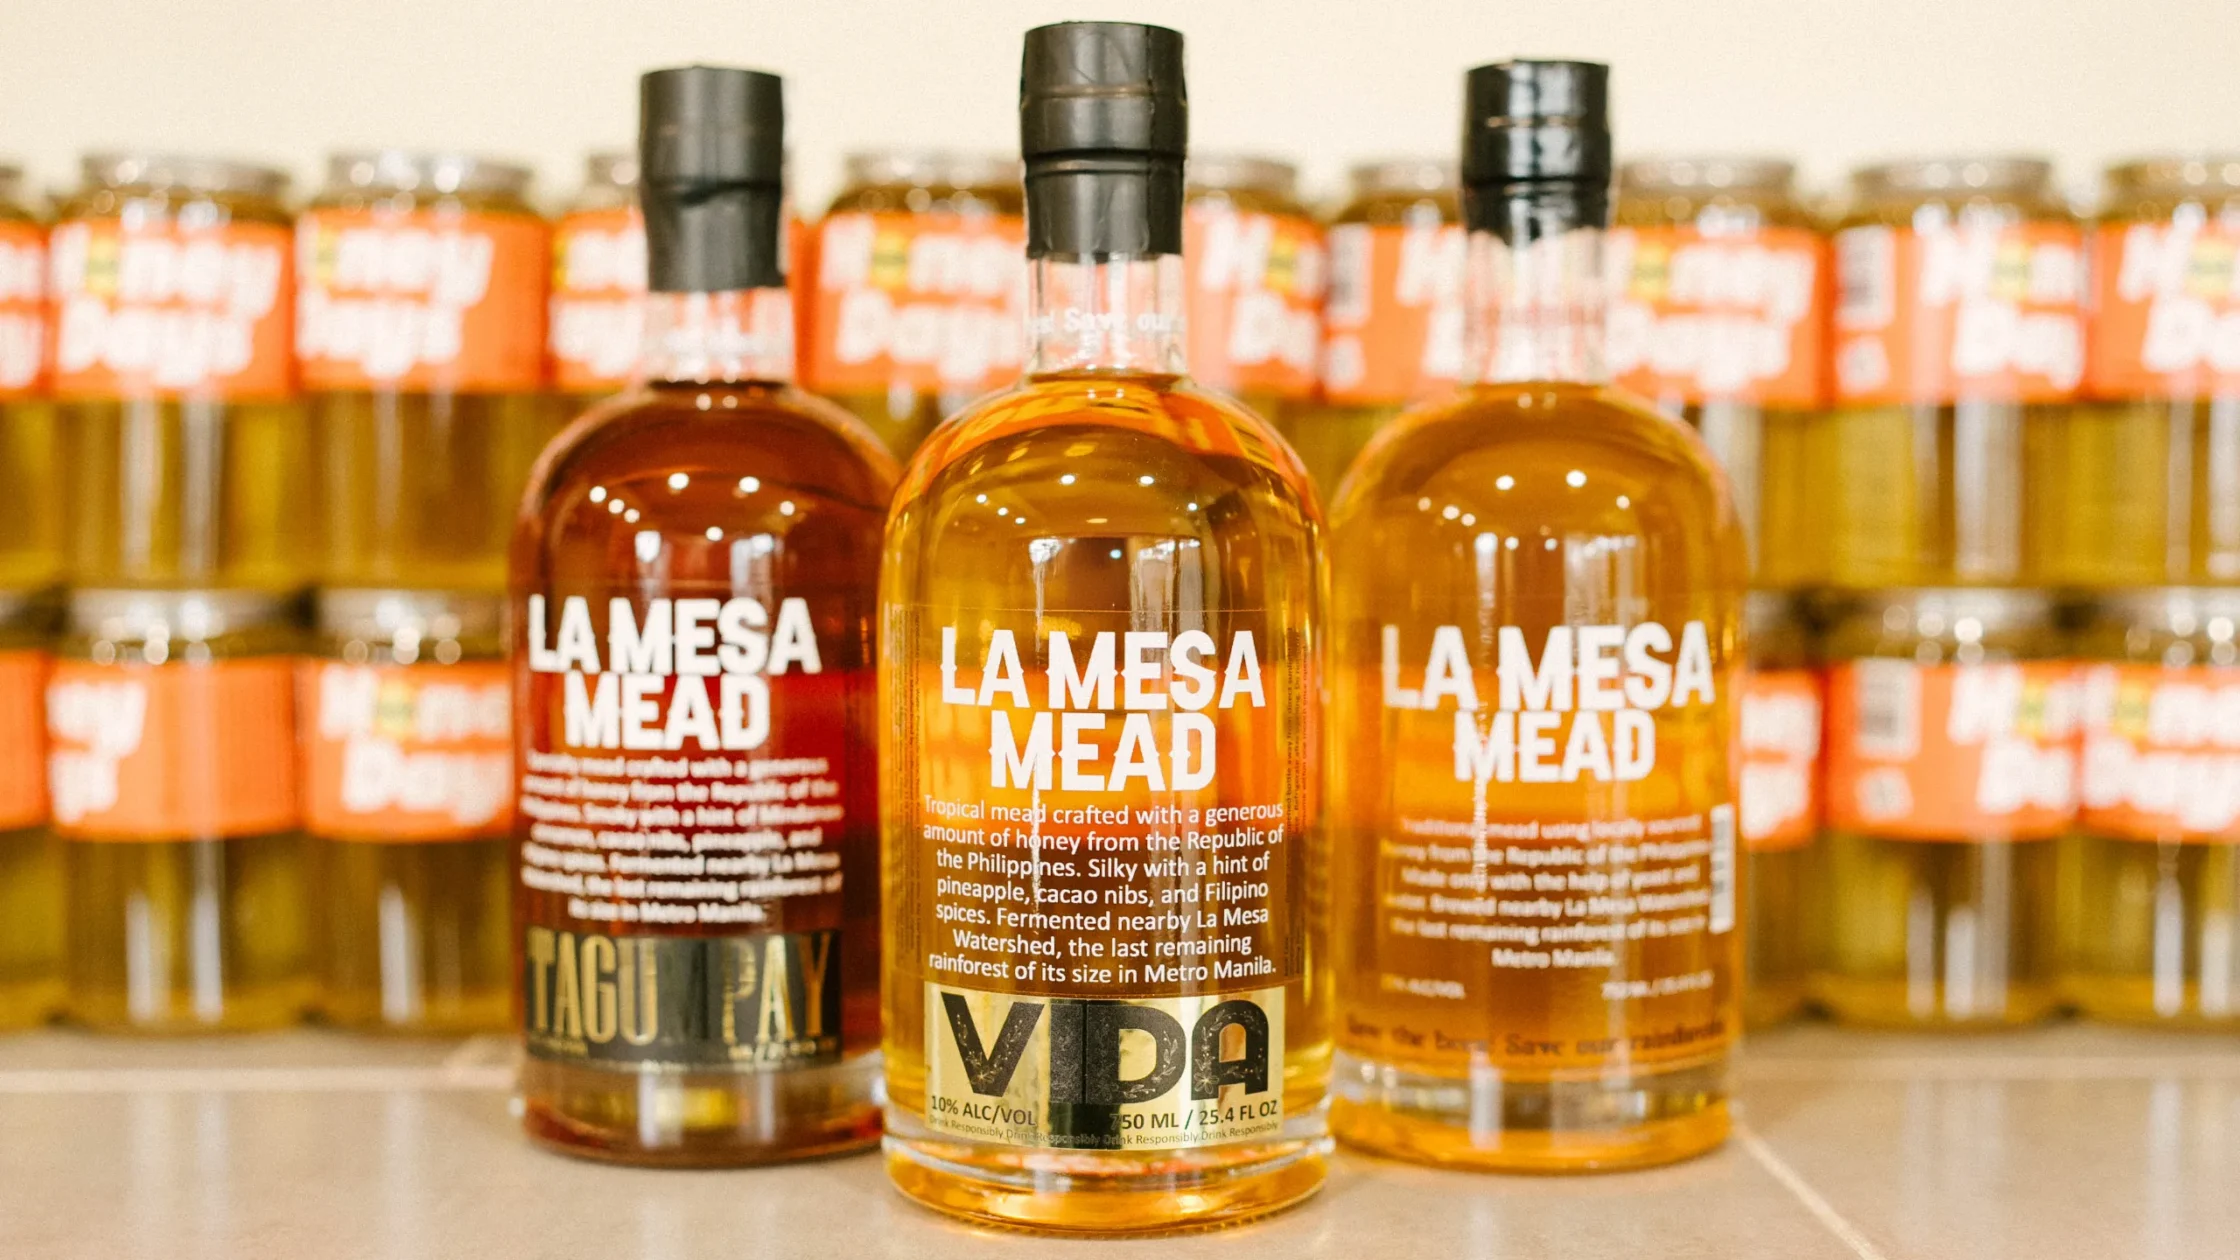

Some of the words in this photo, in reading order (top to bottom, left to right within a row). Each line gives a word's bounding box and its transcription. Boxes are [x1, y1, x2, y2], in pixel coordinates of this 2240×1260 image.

[529, 594, 601, 673] LA
[608, 597, 822, 676] MESA
[940, 627, 1029, 708] LA
[1045, 629, 1265, 710] MESA
[1381, 623, 1478, 711] LA
[1497, 621, 1715, 711] MESA
[564, 670, 770, 750] MEAD
[989, 710, 1216, 791] MEAD
[1454, 709, 1656, 783] MEAD
[924, 794, 985, 819] Tropical
[991, 798, 1047, 828] mead
[1053, 804, 1129, 825] crafted
[1135, 803, 1184, 825] with
[1187, 808, 1200, 824] a
[1205, 804, 1283, 828] generous
[923, 824, 985, 846] amount
[990, 827, 1011, 847] of
[1016, 827, 1081, 859] honey
[1086, 830, 1139, 852] from
[1145, 830, 1181, 852] the
[1186, 827, 1264, 854] Republic
[1268, 823, 1284, 844] of
[936, 847, 963, 869] the
[967, 846, 1081, 883] Philippines.
[1088, 857, 1138, 882] Silky
[1143, 856, 1190, 878] with
[1195, 861, 1207, 876] a
[1213, 855, 1248, 875] hint
[1252, 850, 1270, 872] of
[937, 878, 1030, 905] pineapple,
[1034, 883, 1098, 906] cacao
[1104, 884, 1154, 908] nibs,
[1161, 882, 1199, 904] and
[1205, 880, 1269, 905] Filipino
[936, 903, 991, 925] spices.
[997, 907, 1111, 931] Fermented
[1118, 909, 1192, 935] nearby
[1196, 910, 1217, 928] La
[1223, 907, 1269, 927] Mesa
[952, 928, 1062, 963] Watershed,
[1068, 937, 1104, 957] the
[1111, 937, 1149, 958] last
[1155, 934, 1252, 957] remaining
[929, 953, 1009, 979] rainforest
[1014, 960, 1037, 981] of
[1041, 962, 1066, 982] its
[1072, 964, 1112, 983] size
[1118, 964, 1137, 983] in
[1144, 964, 1209, 983] Metro
[1213, 955, 1277, 980] Manila.
[528, 928, 831, 1046] TAGUPAY
[940, 992, 1269, 1104] VIDA
[931, 1095, 958, 1114] 10%
[963, 1102, 1035, 1125] ALC/VOL
[1110, 1114, 1144, 1130] 750
[1151, 1114, 1179, 1128] ML
[1185, 1110, 1193, 1129] /
[1200, 1108, 1233, 1125] 25.4
[1240, 1106, 1255, 1120] FL
[1260, 1100, 1277, 1116] OZ
[930, 1115, 948, 1127] Drink
[952, 1122, 1003, 1138] Responsibly
[1136, 1134, 1198, 1144] Responsibly
[1201, 1131, 1226, 1140] Drink
[1230, 1123, 1277, 1137] Responsibly
